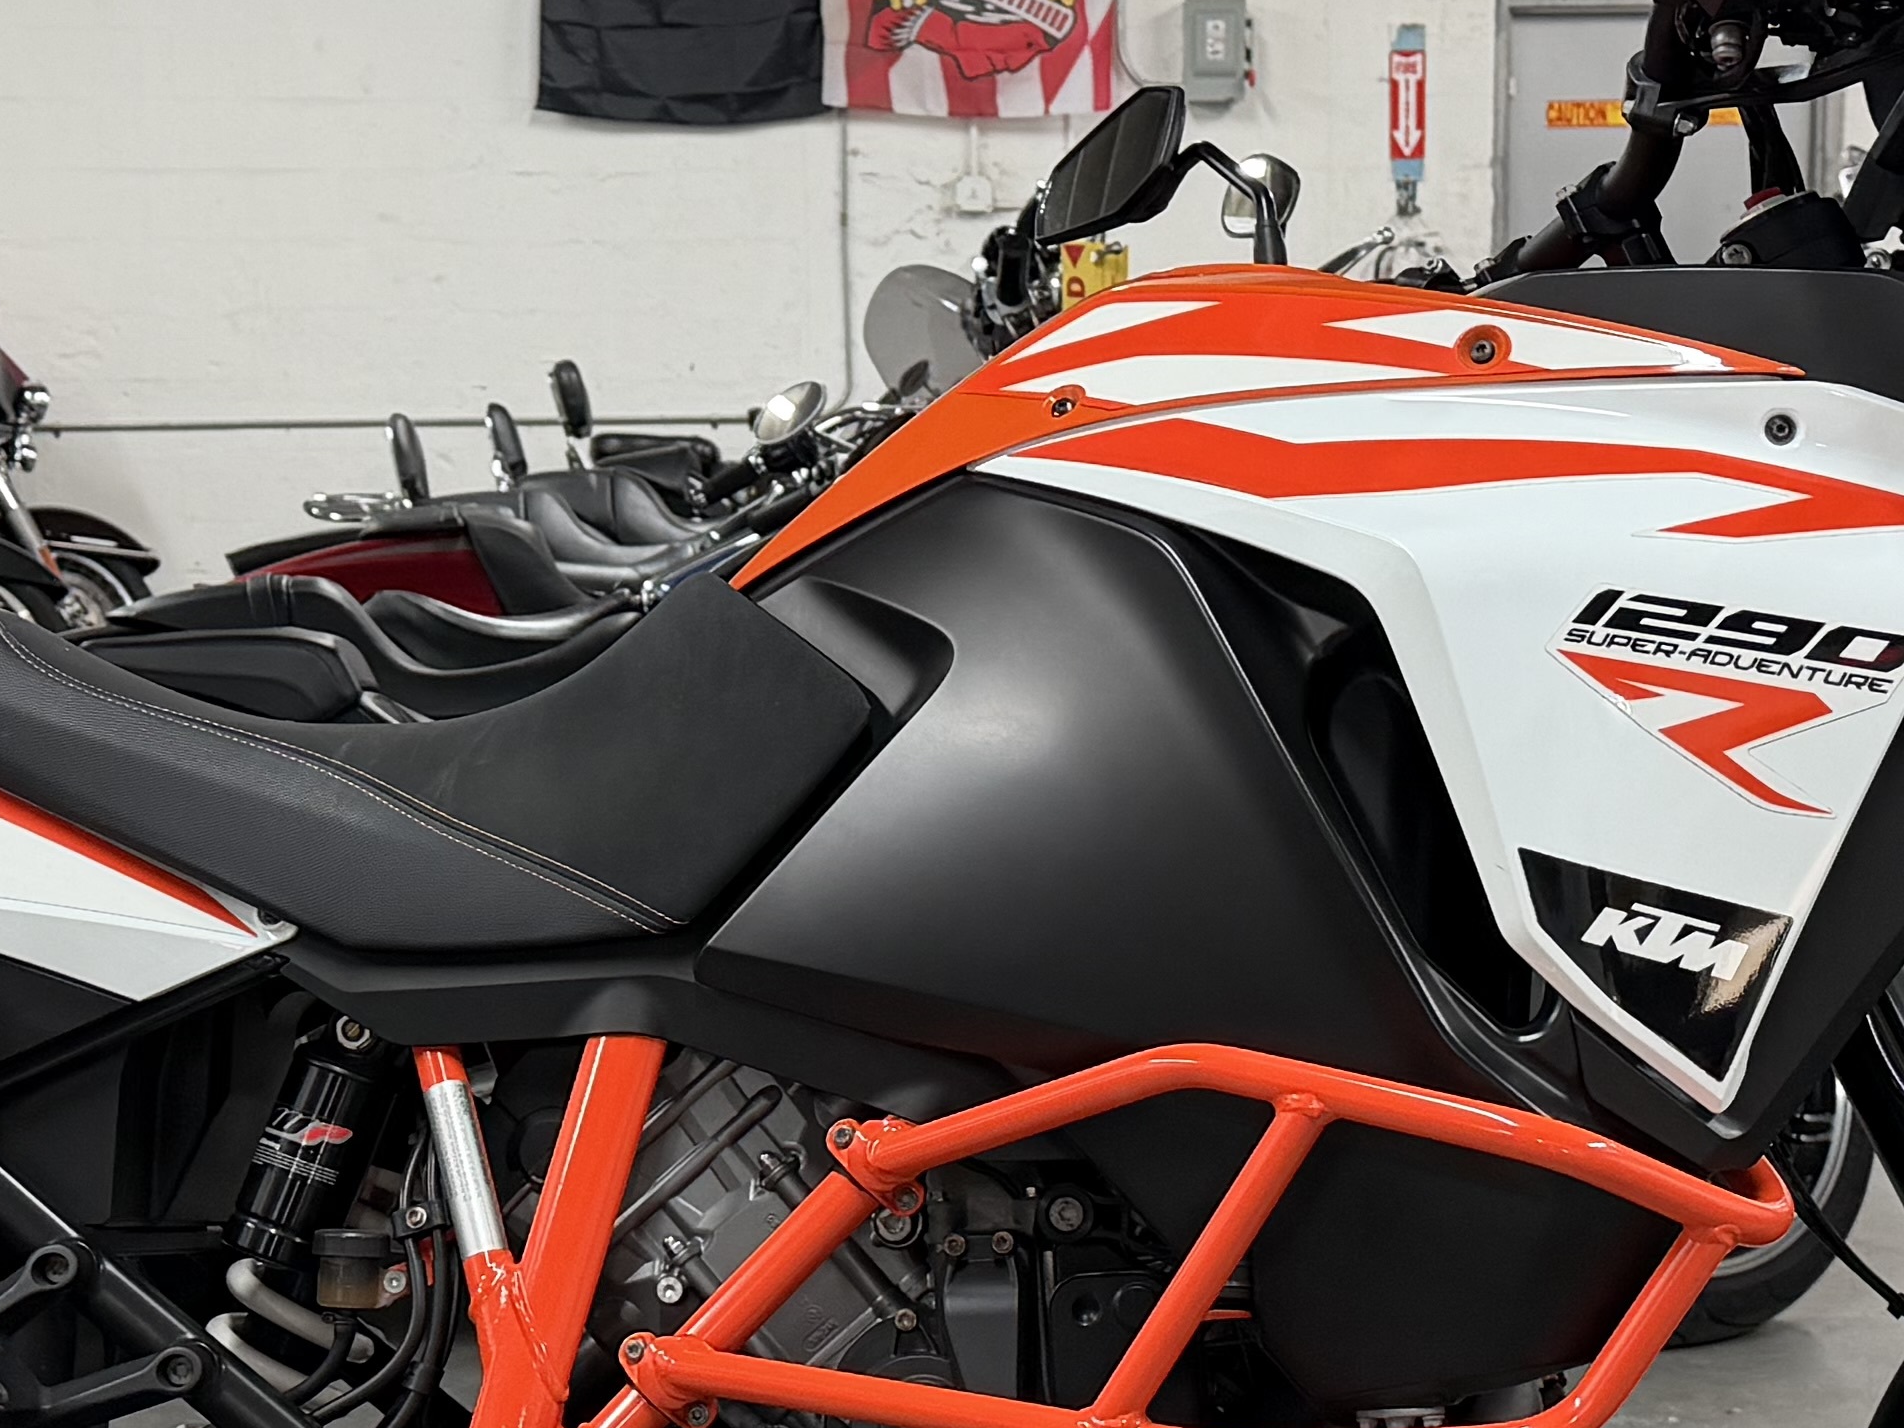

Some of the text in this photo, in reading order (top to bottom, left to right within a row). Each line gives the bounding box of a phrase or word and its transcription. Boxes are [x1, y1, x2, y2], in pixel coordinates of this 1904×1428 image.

[1548, 101, 1609, 124] CAUTION
[1563, 627, 1895, 696] SUPER-ADVENTURE
[1580, 902, 1749, 981] KTM
